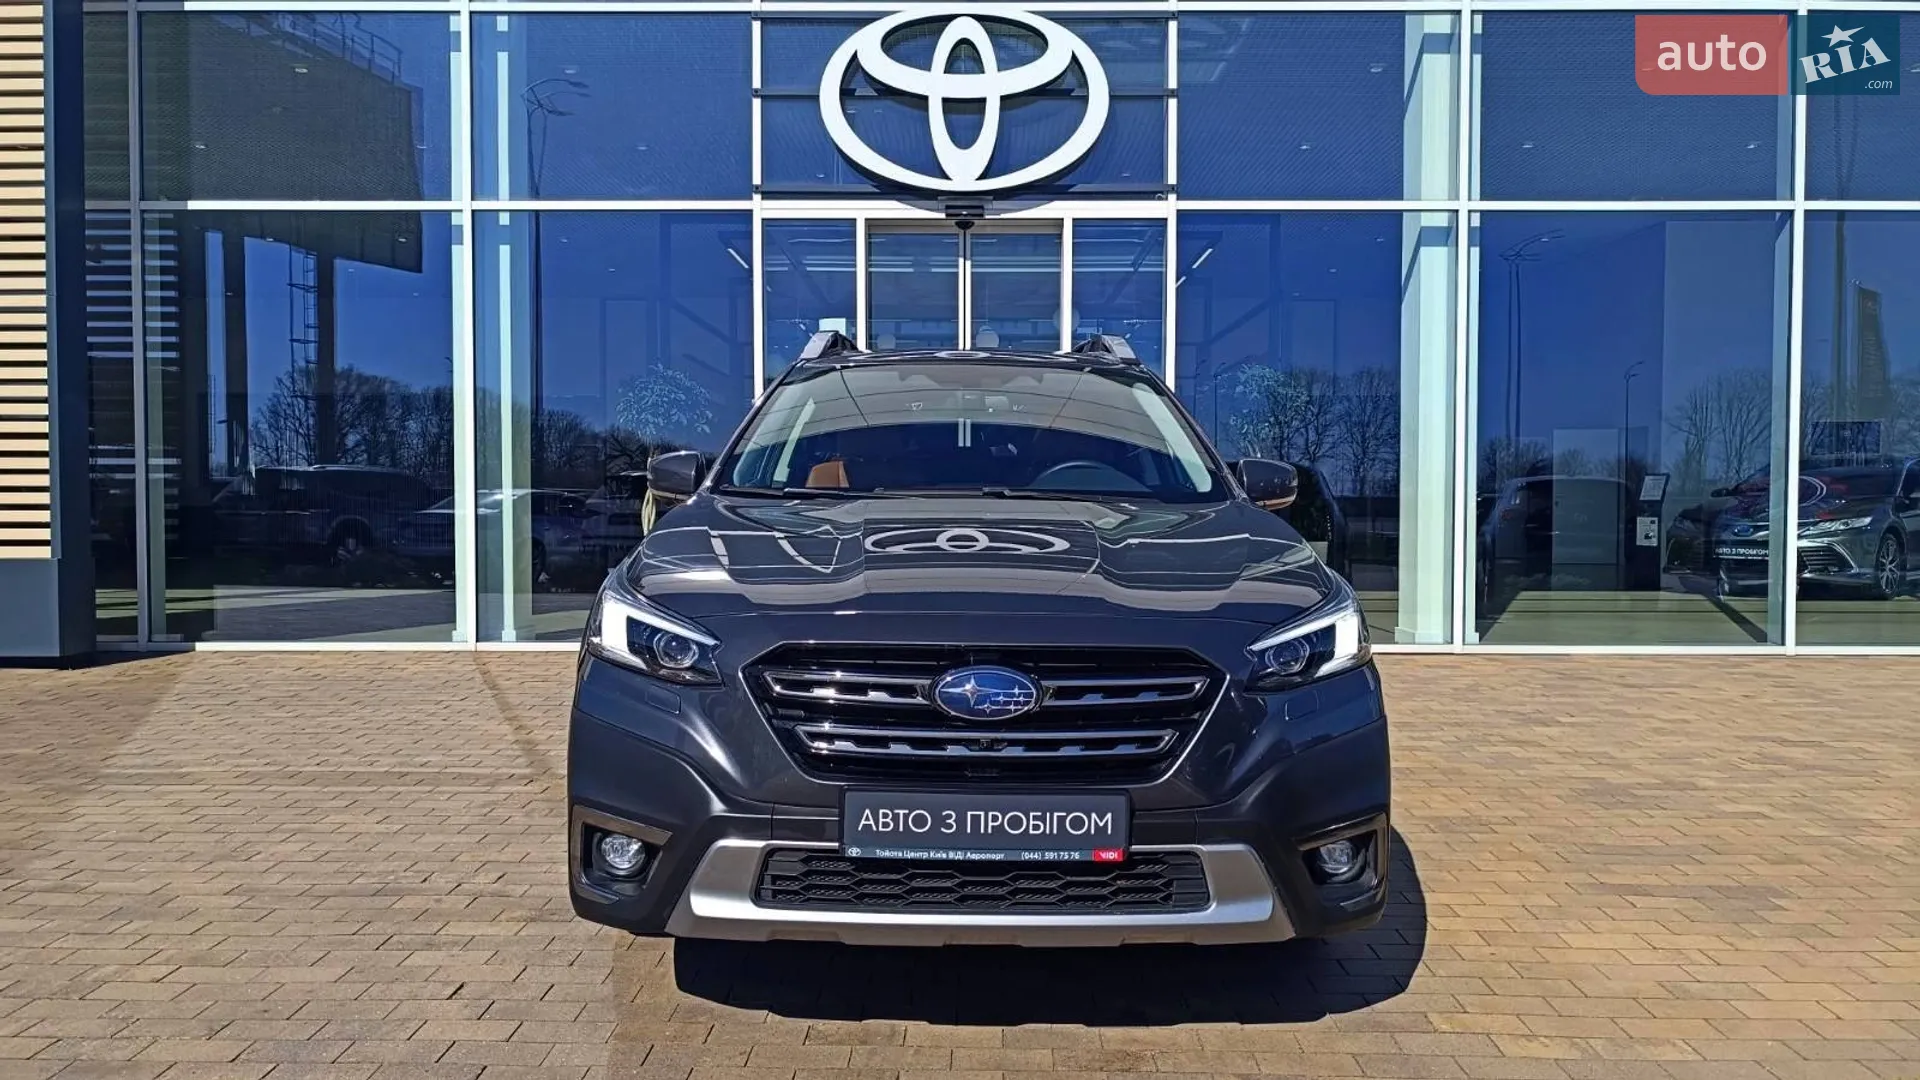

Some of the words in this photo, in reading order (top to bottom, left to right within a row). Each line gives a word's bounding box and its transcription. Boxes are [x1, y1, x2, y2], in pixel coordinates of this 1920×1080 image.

[858, 808, 932, 833] АВТО
[940, 810, 957, 834] З
[966, 810, 1113, 836] ПРОБІГОМ
[875, 849, 903, 858] Тойота
[903, 850, 929, 860] Центр
[965, 851, 1005, 861] Аеропорт
[1021, 851, 1042, 861] (044)
[1045, 851, 1058, 860] 591
[1059, 851, 1069, 860] 75
